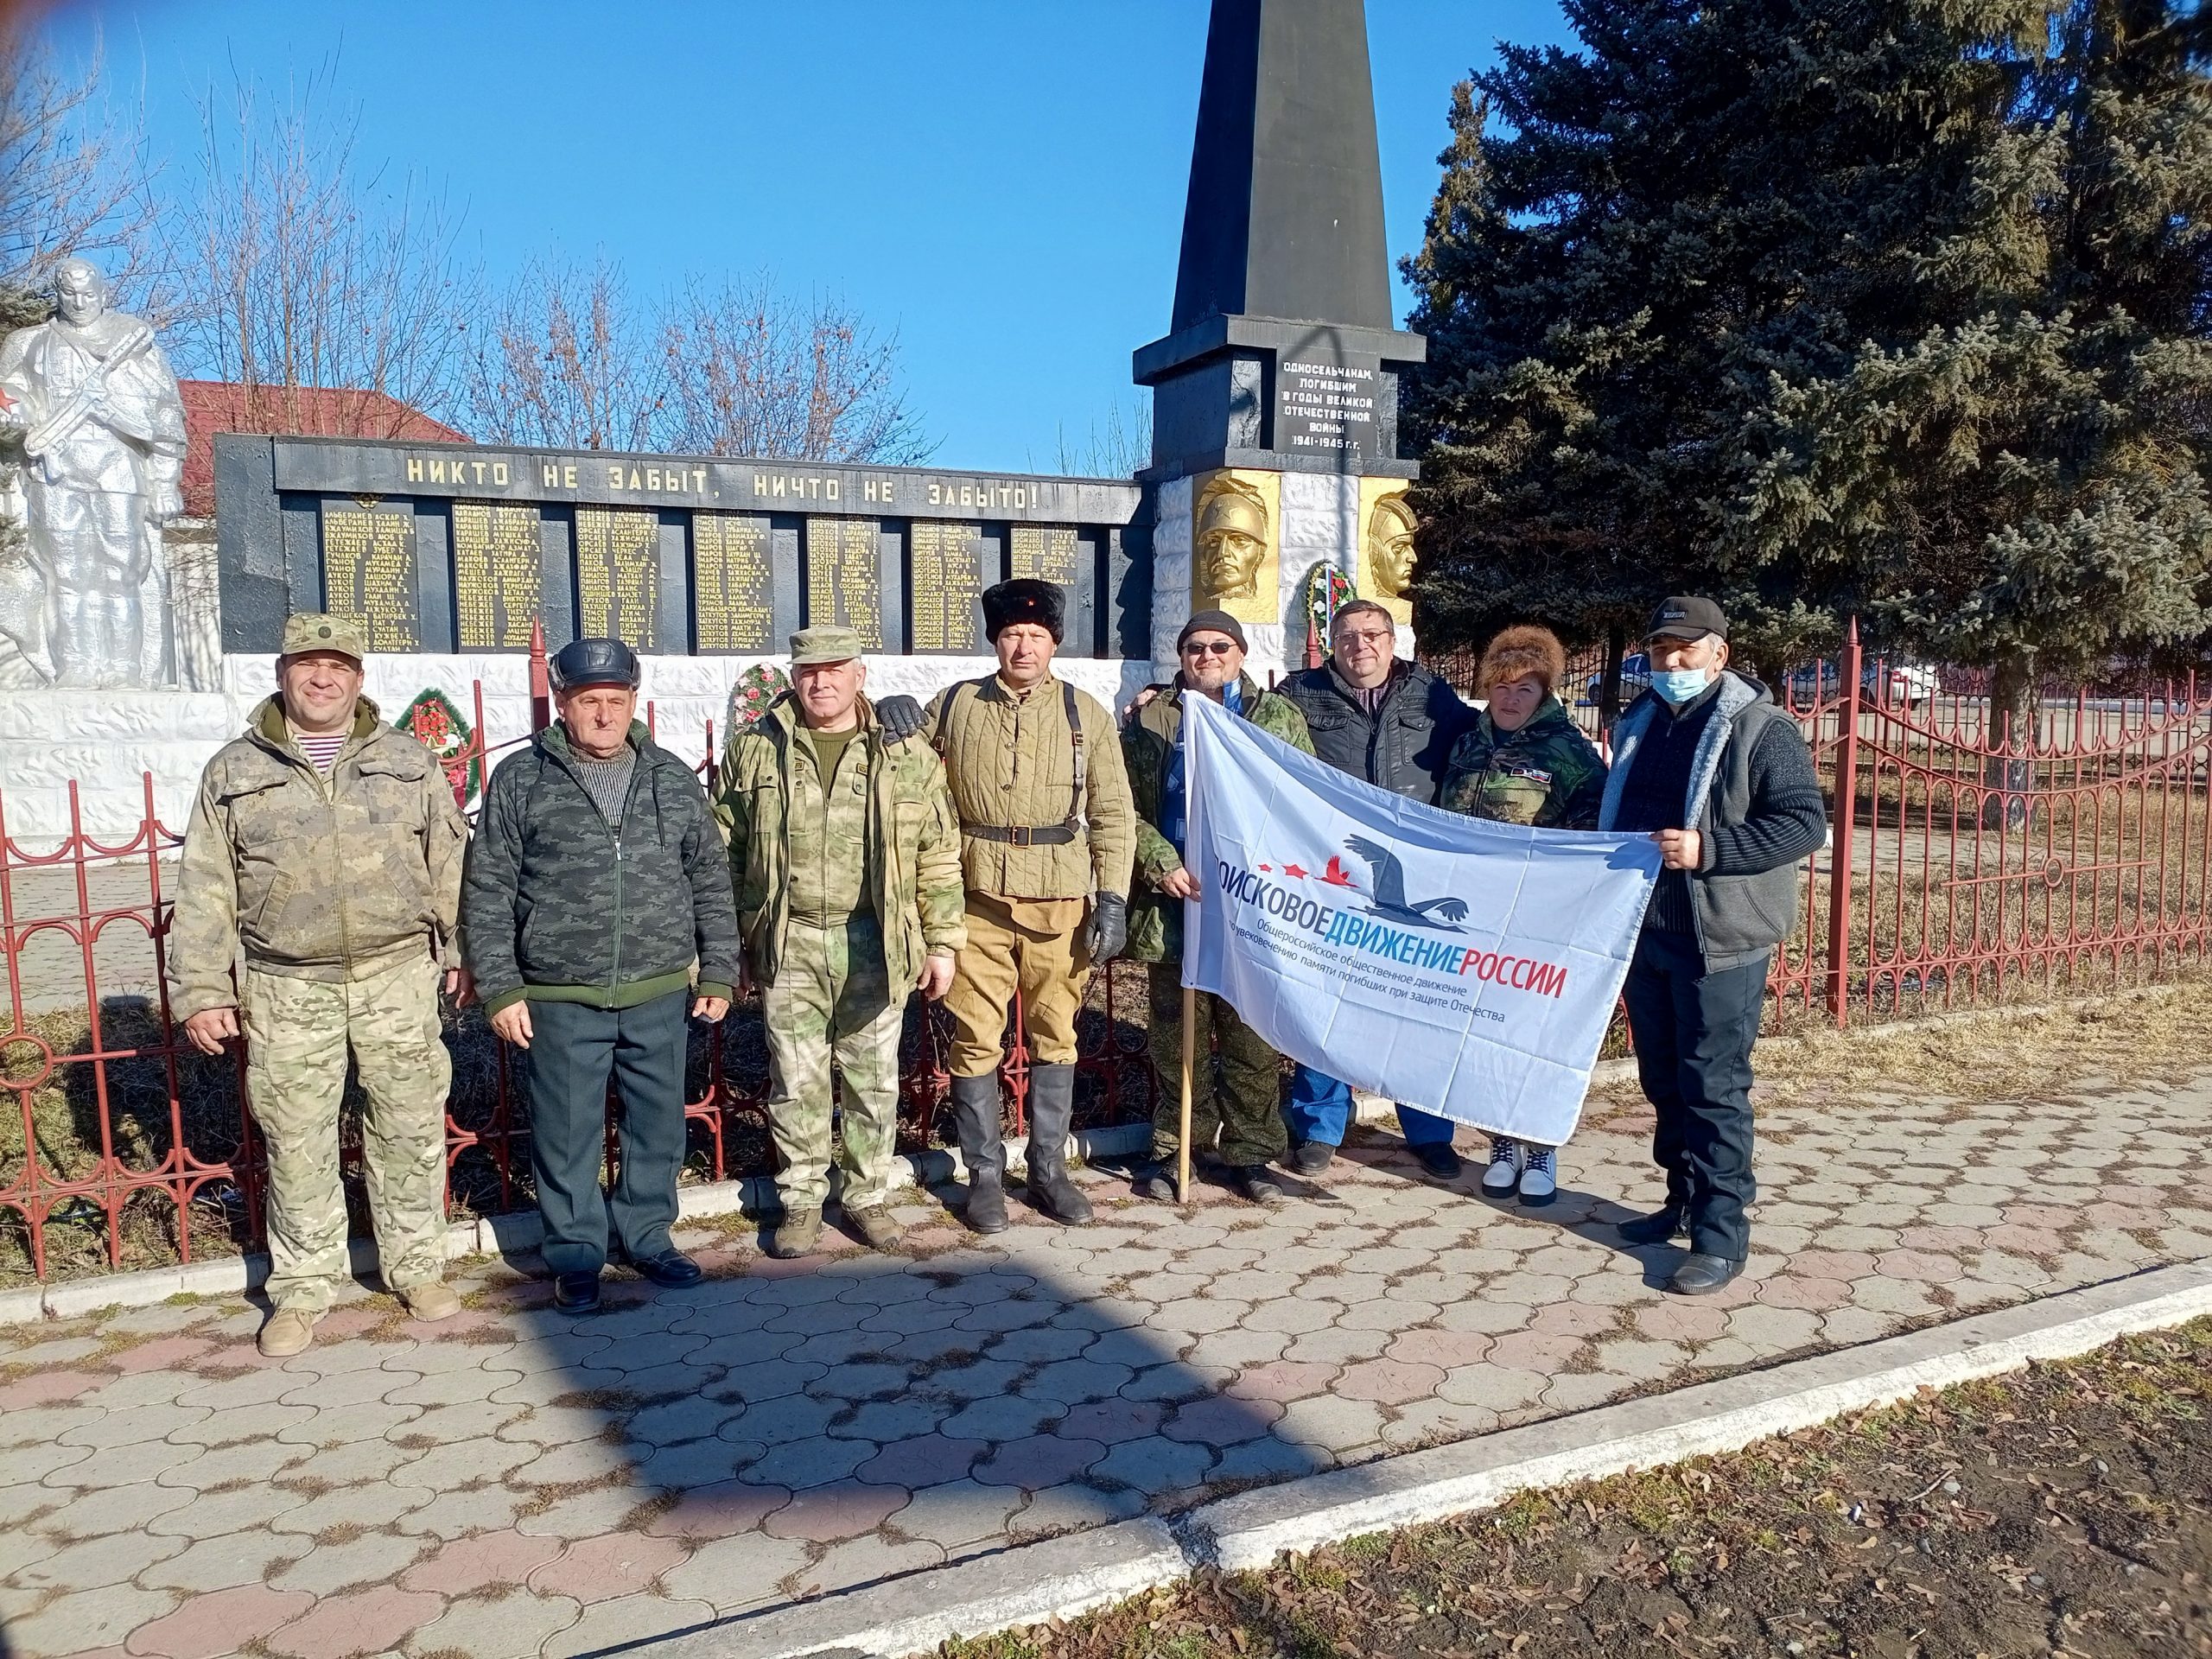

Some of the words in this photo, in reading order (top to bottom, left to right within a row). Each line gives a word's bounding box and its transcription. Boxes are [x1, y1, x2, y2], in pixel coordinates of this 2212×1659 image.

[1284, 362, 1373, 381] ОДНОСЕЛЬЧАНАМ,
[1300, 378, 1357, 392] ПОГИБШИМ
[1283, 391, 1290, 401] В
[1293, 392, 1322, 404] ГОДЫ
[1327, 395, 1372, 408] ВЕЛИКОЙ
[1285, 405, 1371, 422] ОТЕЧЕСТВЕННОЙ
[1310, 423, 1344, 434] ВОЙНЫ
[1294, 435, 1343, 448] 1941-1945
[408, 459, 509, 486] НИКТО
[543, 465, 578, 488] НЕ
[608, 466, 720, 498] ЗАБЫТ,
[754, 474, 839, 500] НИЧТО
[865, 480, 894, 502] НЕ
[928, 484, 1038, 509] ЗАБЫТО!
[1257, 918, 1338, 961] Общероссийское
[1340, 954, 1414, 984] общественное
[1414, 977, 1467, 997] движение
[1236, 927, 1298, 961] увековечению
[1300, 956, 1337, 976] памяти
[1338, 969, 1387, 993] погибших
[1389, 987, 1408, 999] при
[1409, 991, 1448, 1008] защите
[1451, 1000, 1505, 1022] Отечества
